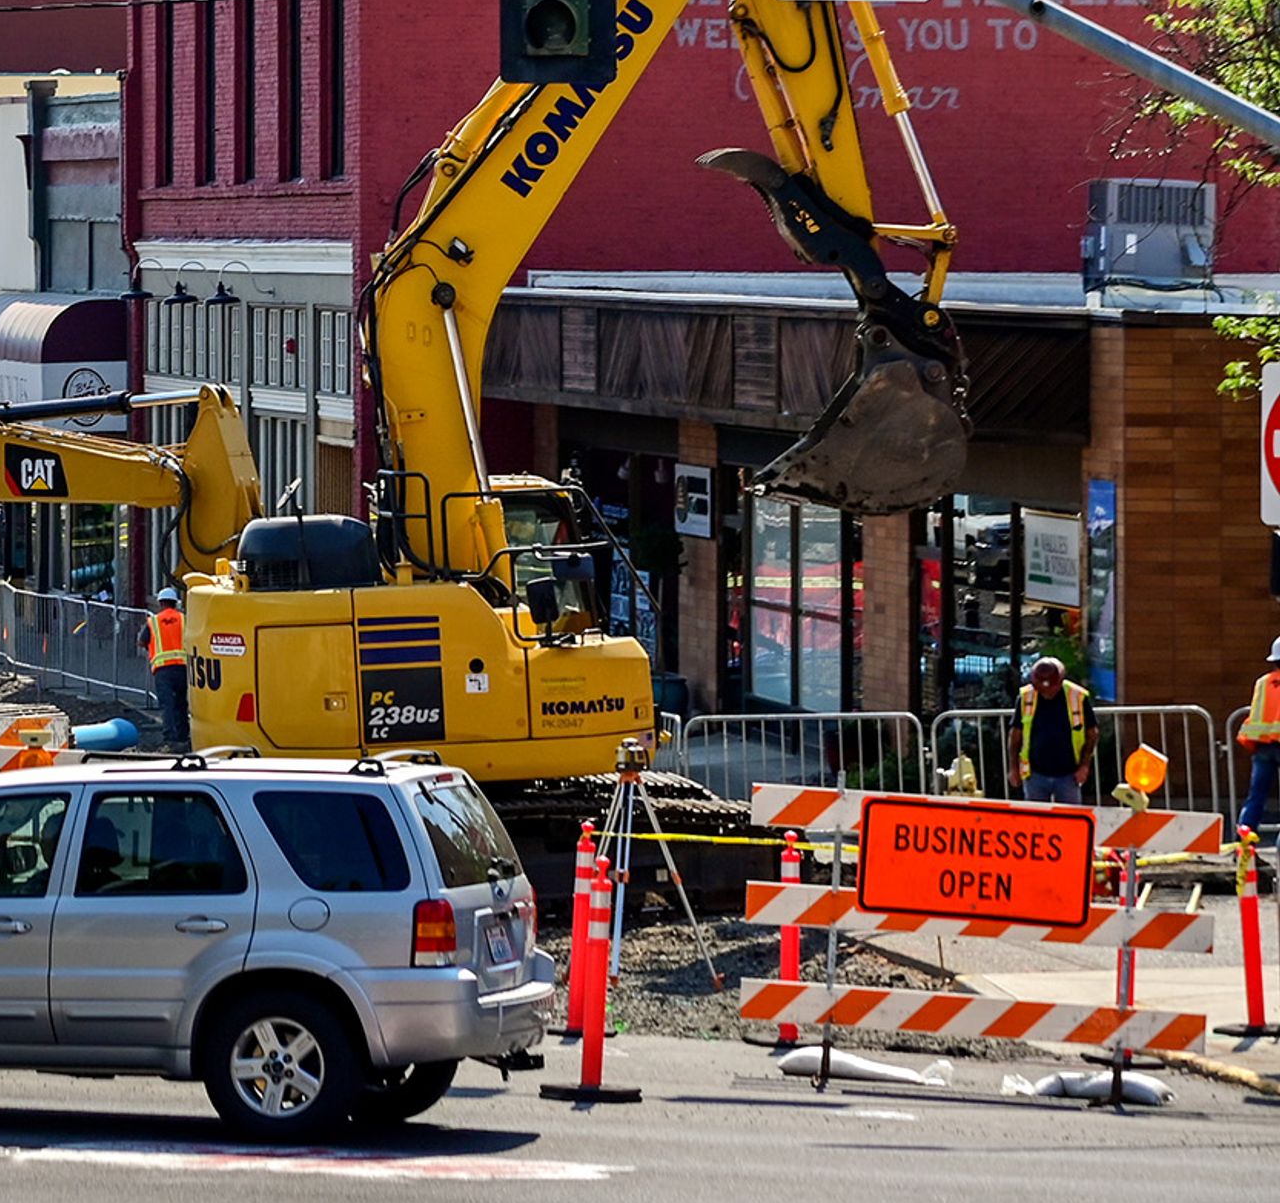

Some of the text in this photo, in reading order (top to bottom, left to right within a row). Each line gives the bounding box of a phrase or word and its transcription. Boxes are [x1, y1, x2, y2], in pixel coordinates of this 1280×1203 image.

[898, 17, 972, 52] YOU
[987, 17, 1041, 51] TO
[20, 457, 56, 490] CAT
[370, 690, 395, 706] PC
[541, 695, 626, 715] KOMATSU
[371, 726, 389, 739] LC
[893, 823, 1063, 862] BUSINESSES
[938, 869, 1012, 901] OPEN
